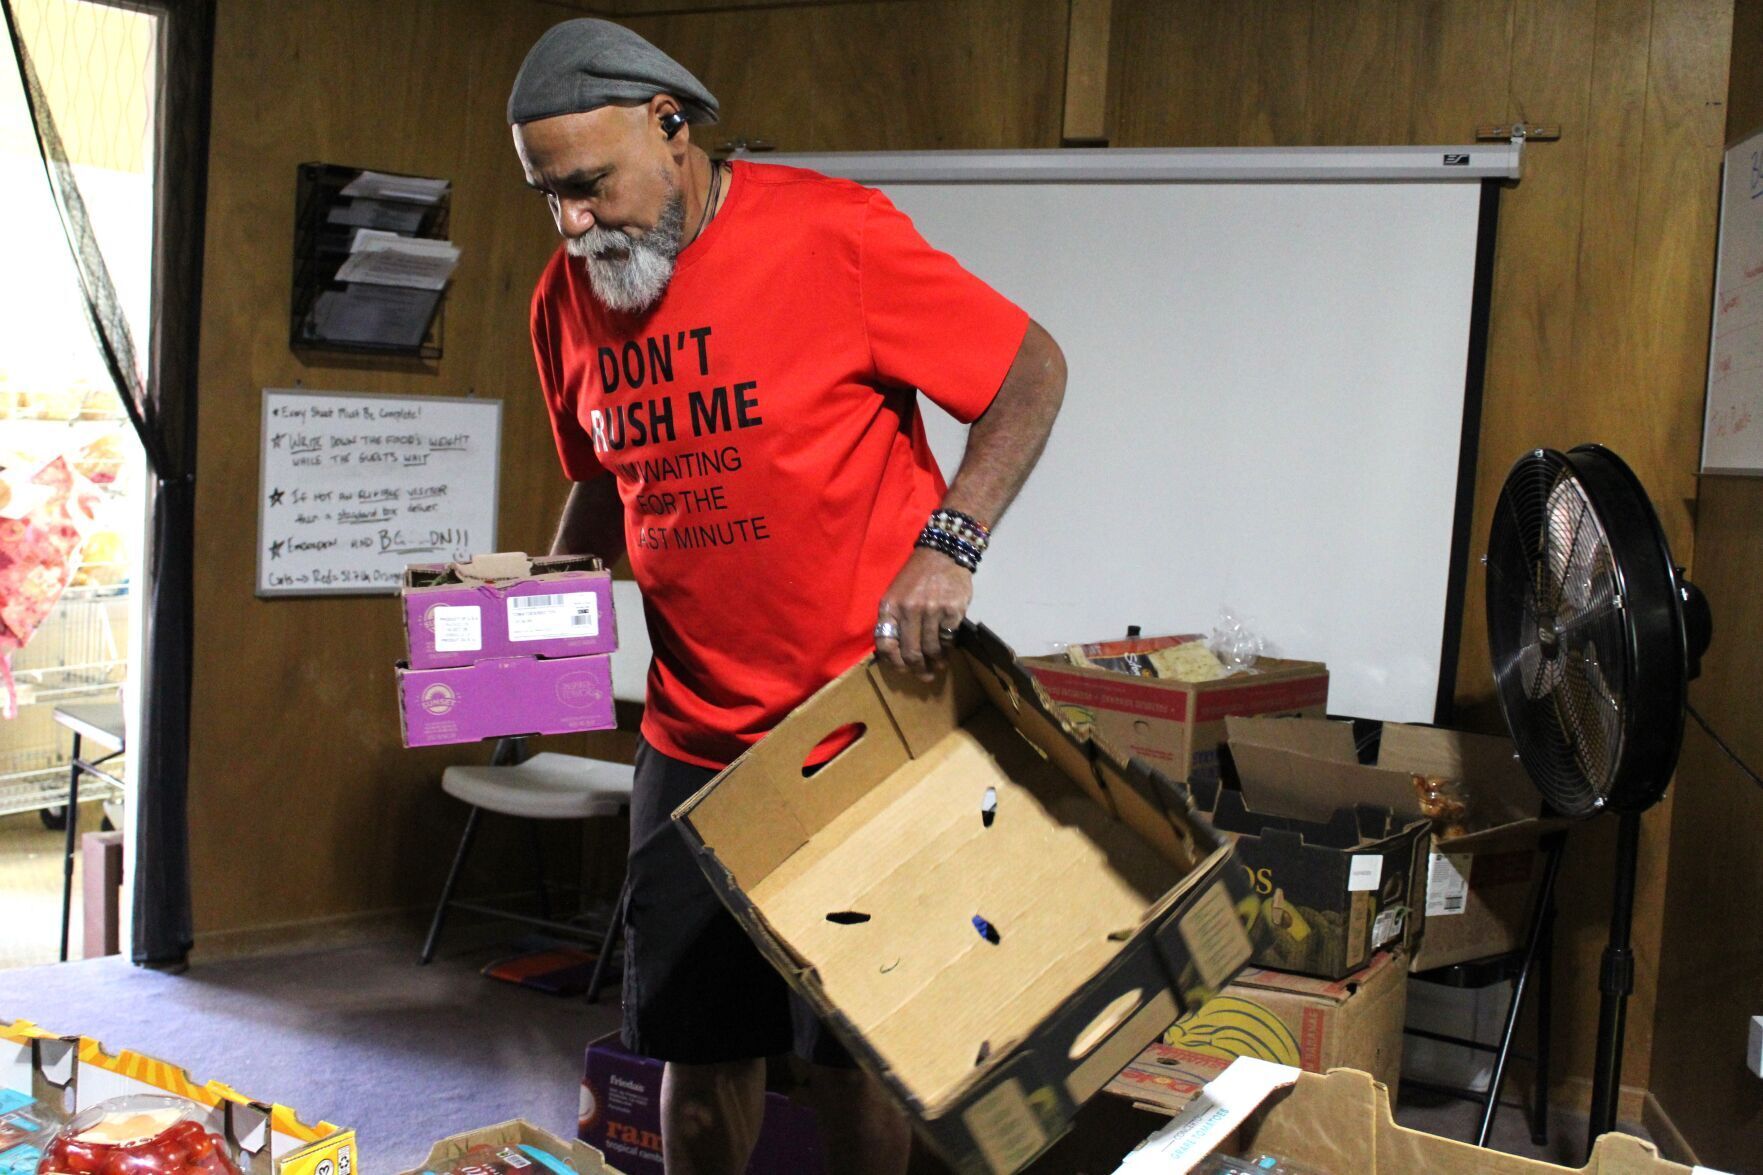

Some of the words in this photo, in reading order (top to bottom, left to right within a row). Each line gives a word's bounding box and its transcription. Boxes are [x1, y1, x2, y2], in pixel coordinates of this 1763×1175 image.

[598, 326, 711, 394] DON'T
[590, 397, 676, 453] RUSH
[689, 381, 763, 437] ME
[331, 436, 356, 447] DOWN
[361, 435, 383, 446] THE
[331, 453, 351, 464] THE
[637, 446, 742, 484] WAITING
[636, 493, 678, 515] FOR
[679, 486, 728, 514] THE
[638, 527, 667, 550] AST
[674, 516, 770, 549] MINUTE
